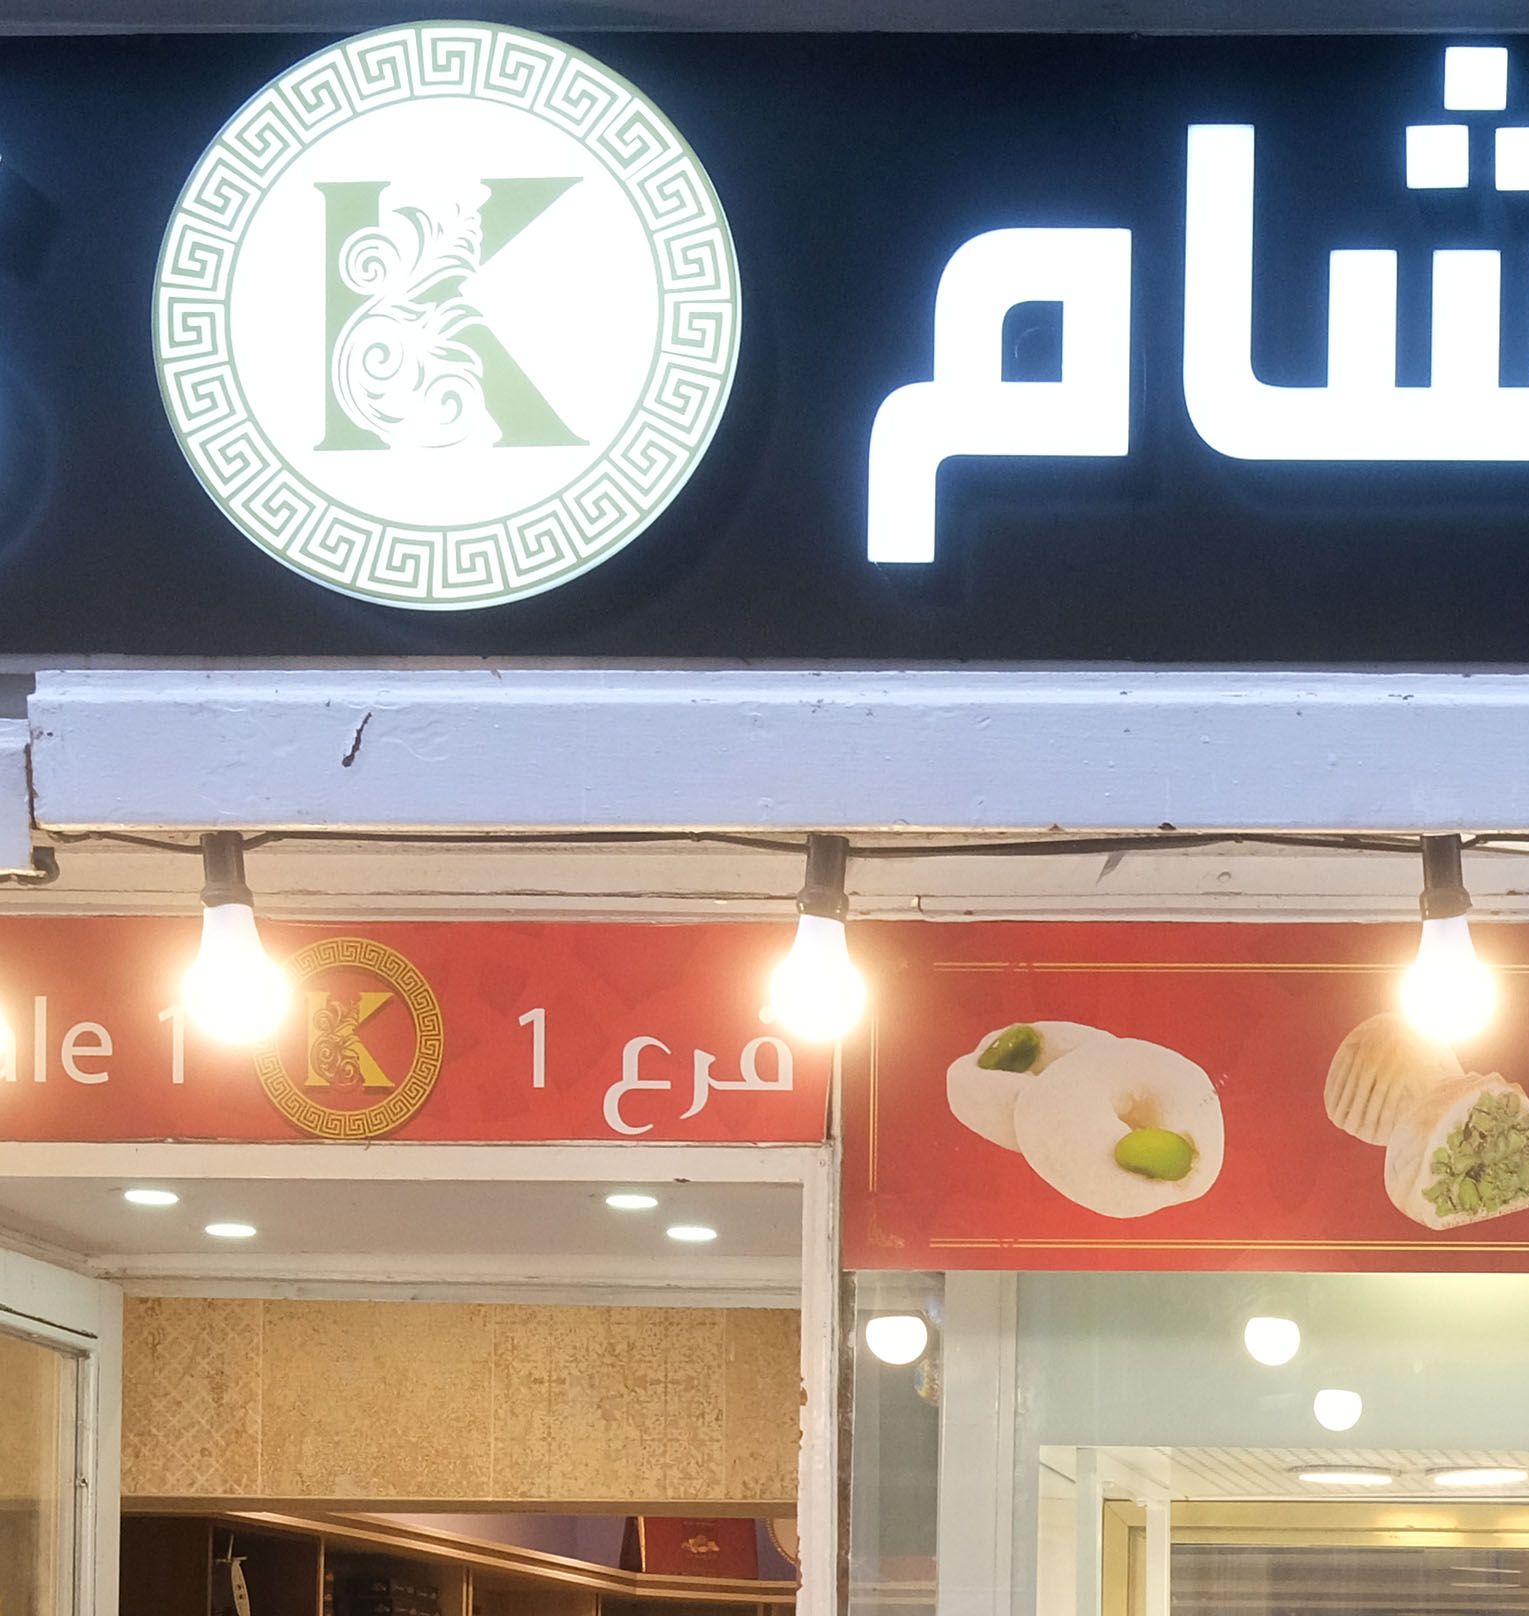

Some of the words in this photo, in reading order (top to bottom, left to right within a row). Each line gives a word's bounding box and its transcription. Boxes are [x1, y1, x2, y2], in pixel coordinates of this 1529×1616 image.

[313, 176, 589, 451] K
[304, 991, 396, 1087] K
[518, 1008, 546, 1088] 1
[603, 1004, 794, 1134] فرع
